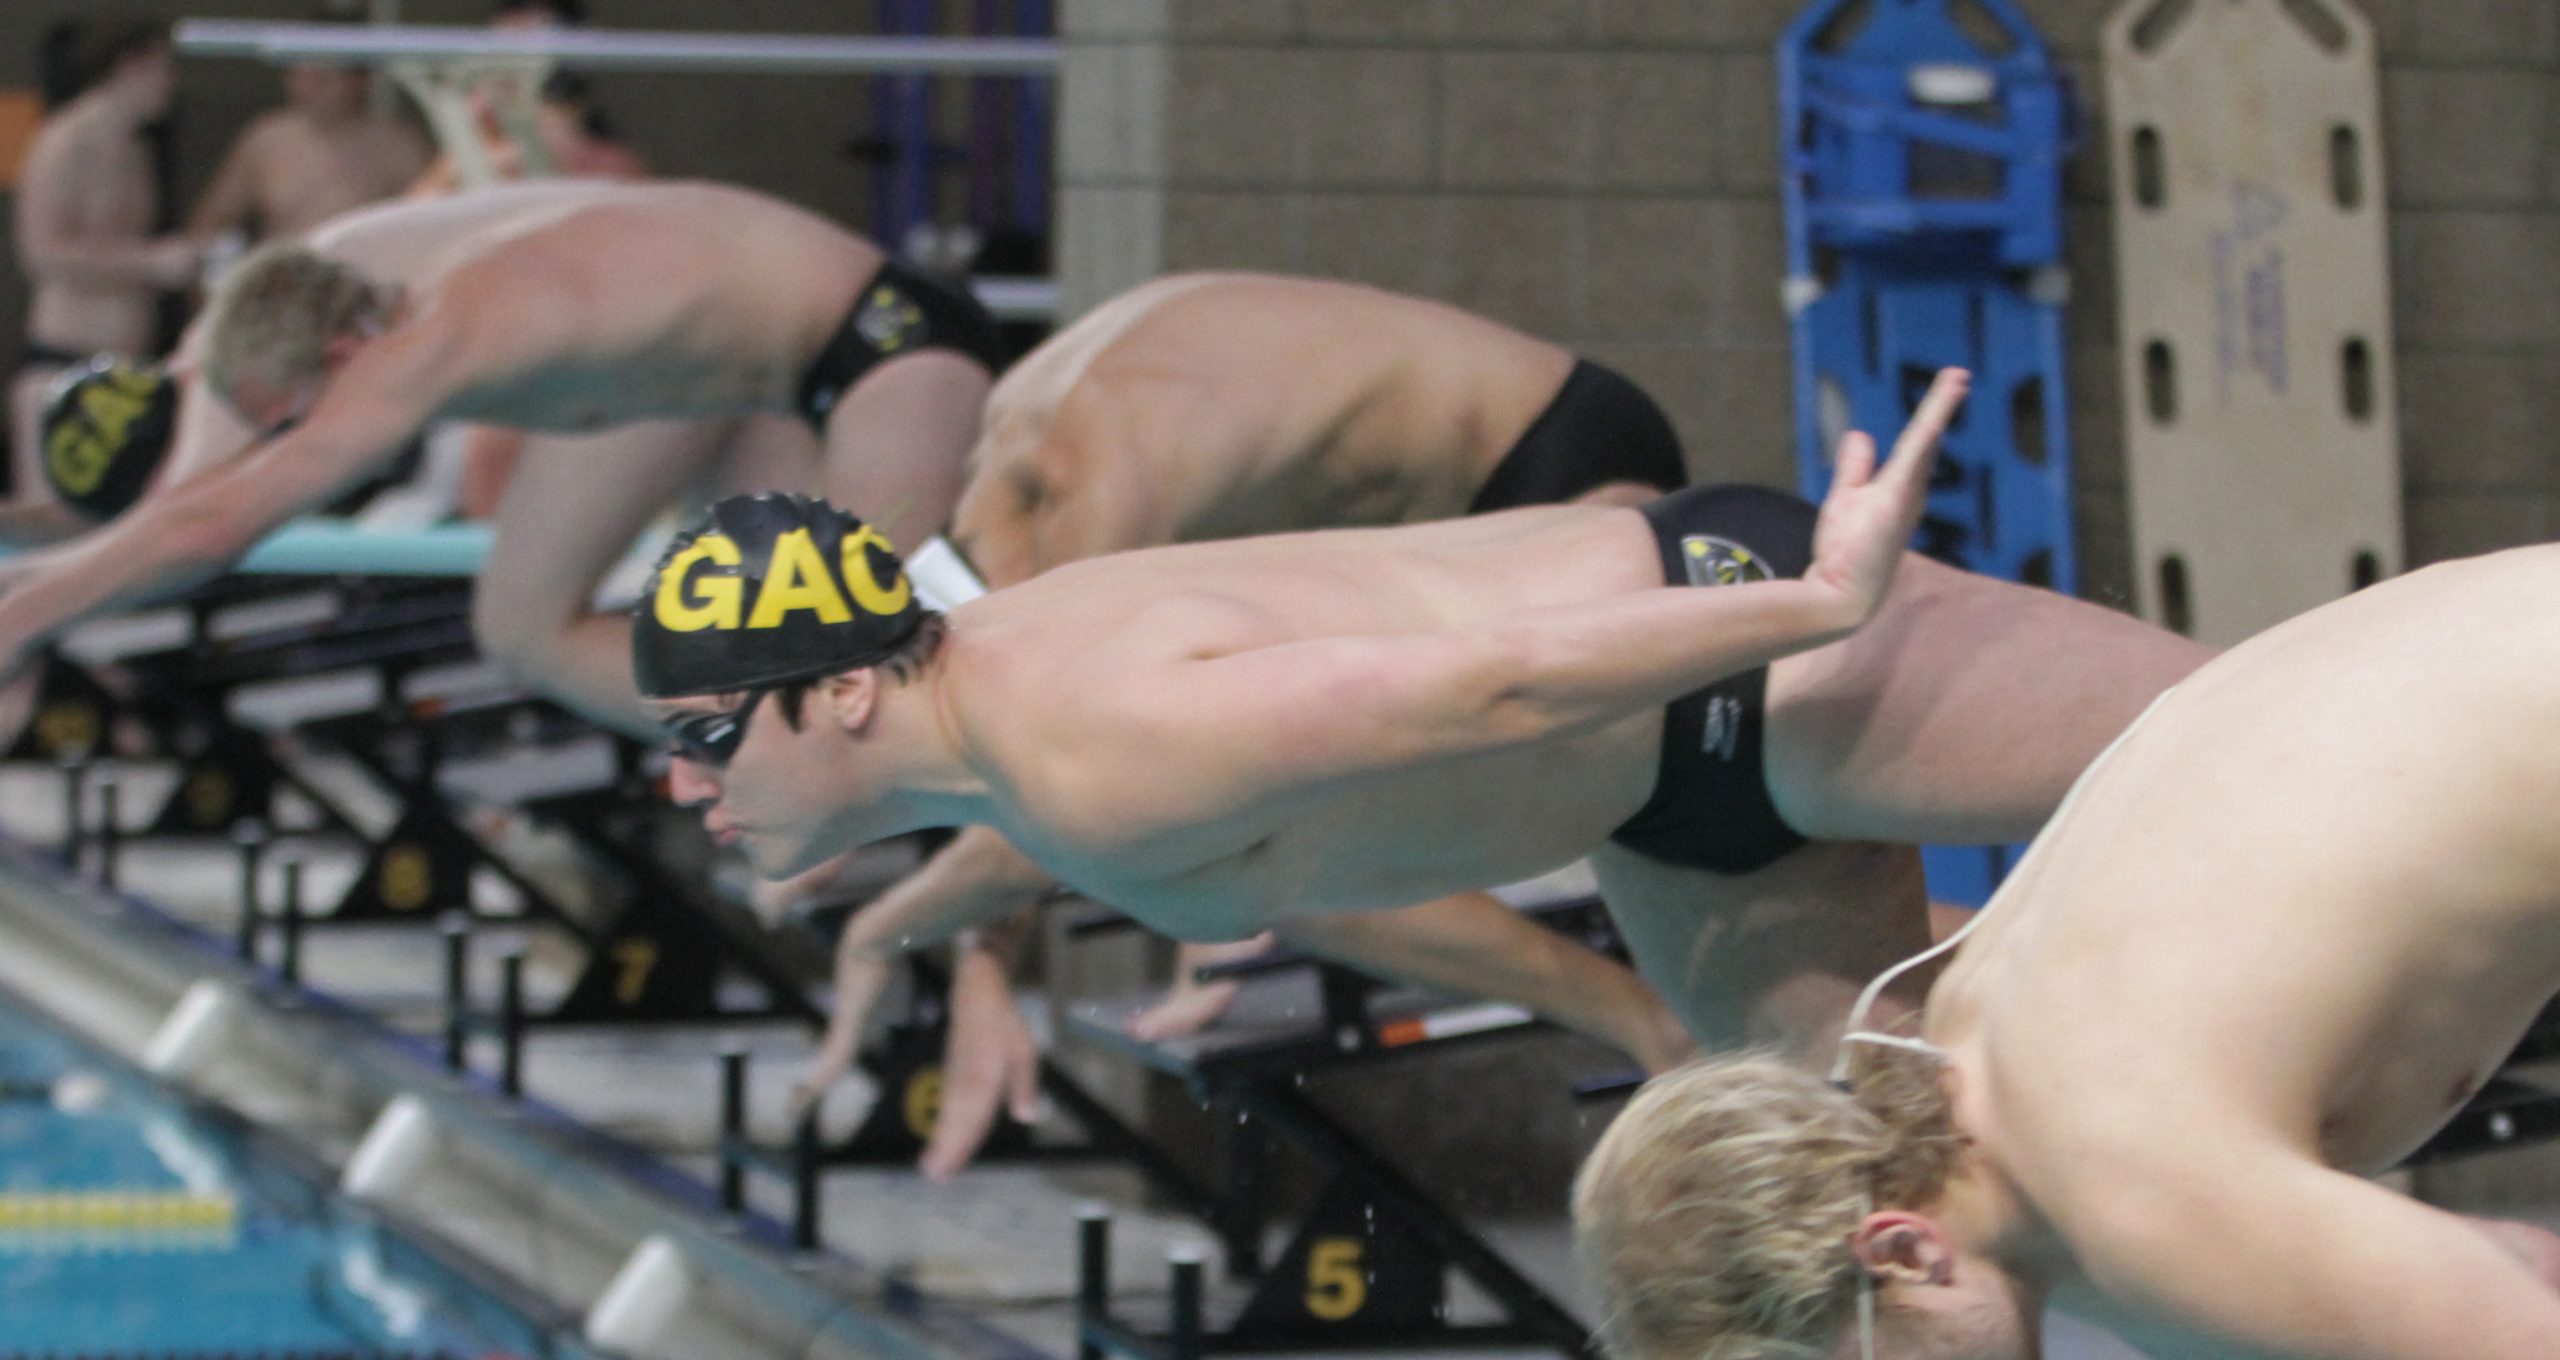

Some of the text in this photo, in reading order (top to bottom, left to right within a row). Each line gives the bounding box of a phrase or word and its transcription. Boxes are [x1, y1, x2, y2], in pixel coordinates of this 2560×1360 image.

[655, 524, 911, 632] GAC
[613, 942, 657, 1004] 7
[1304, 1239, 1367, 1321] 5
